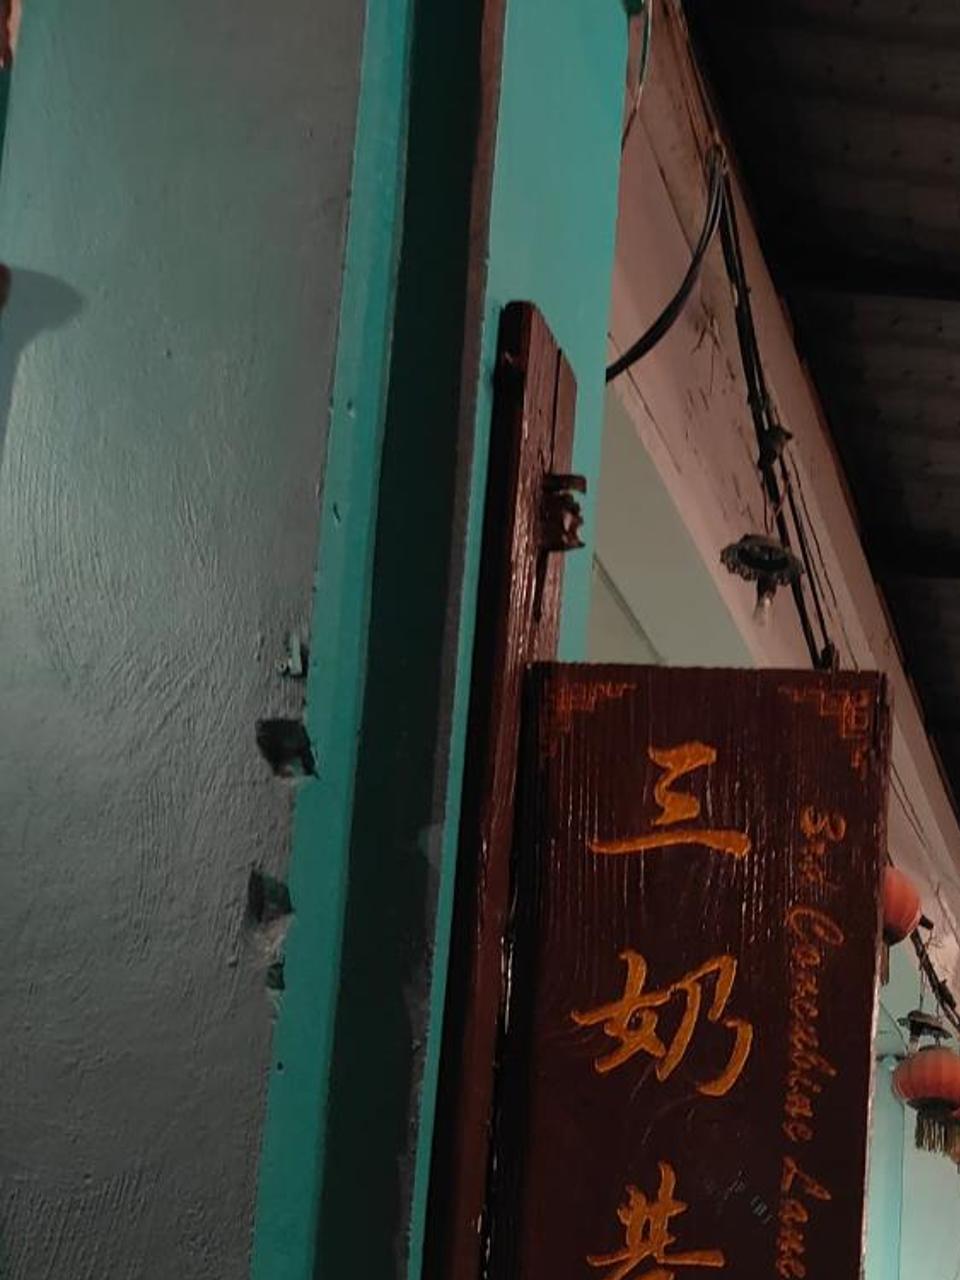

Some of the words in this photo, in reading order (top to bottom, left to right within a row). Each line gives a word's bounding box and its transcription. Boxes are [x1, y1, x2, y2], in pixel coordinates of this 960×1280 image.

[798, 805, 847, 893] 3rd
[781, 906, 845, 1141] Concubine
[776, 1156, 832, 1280] Lane
